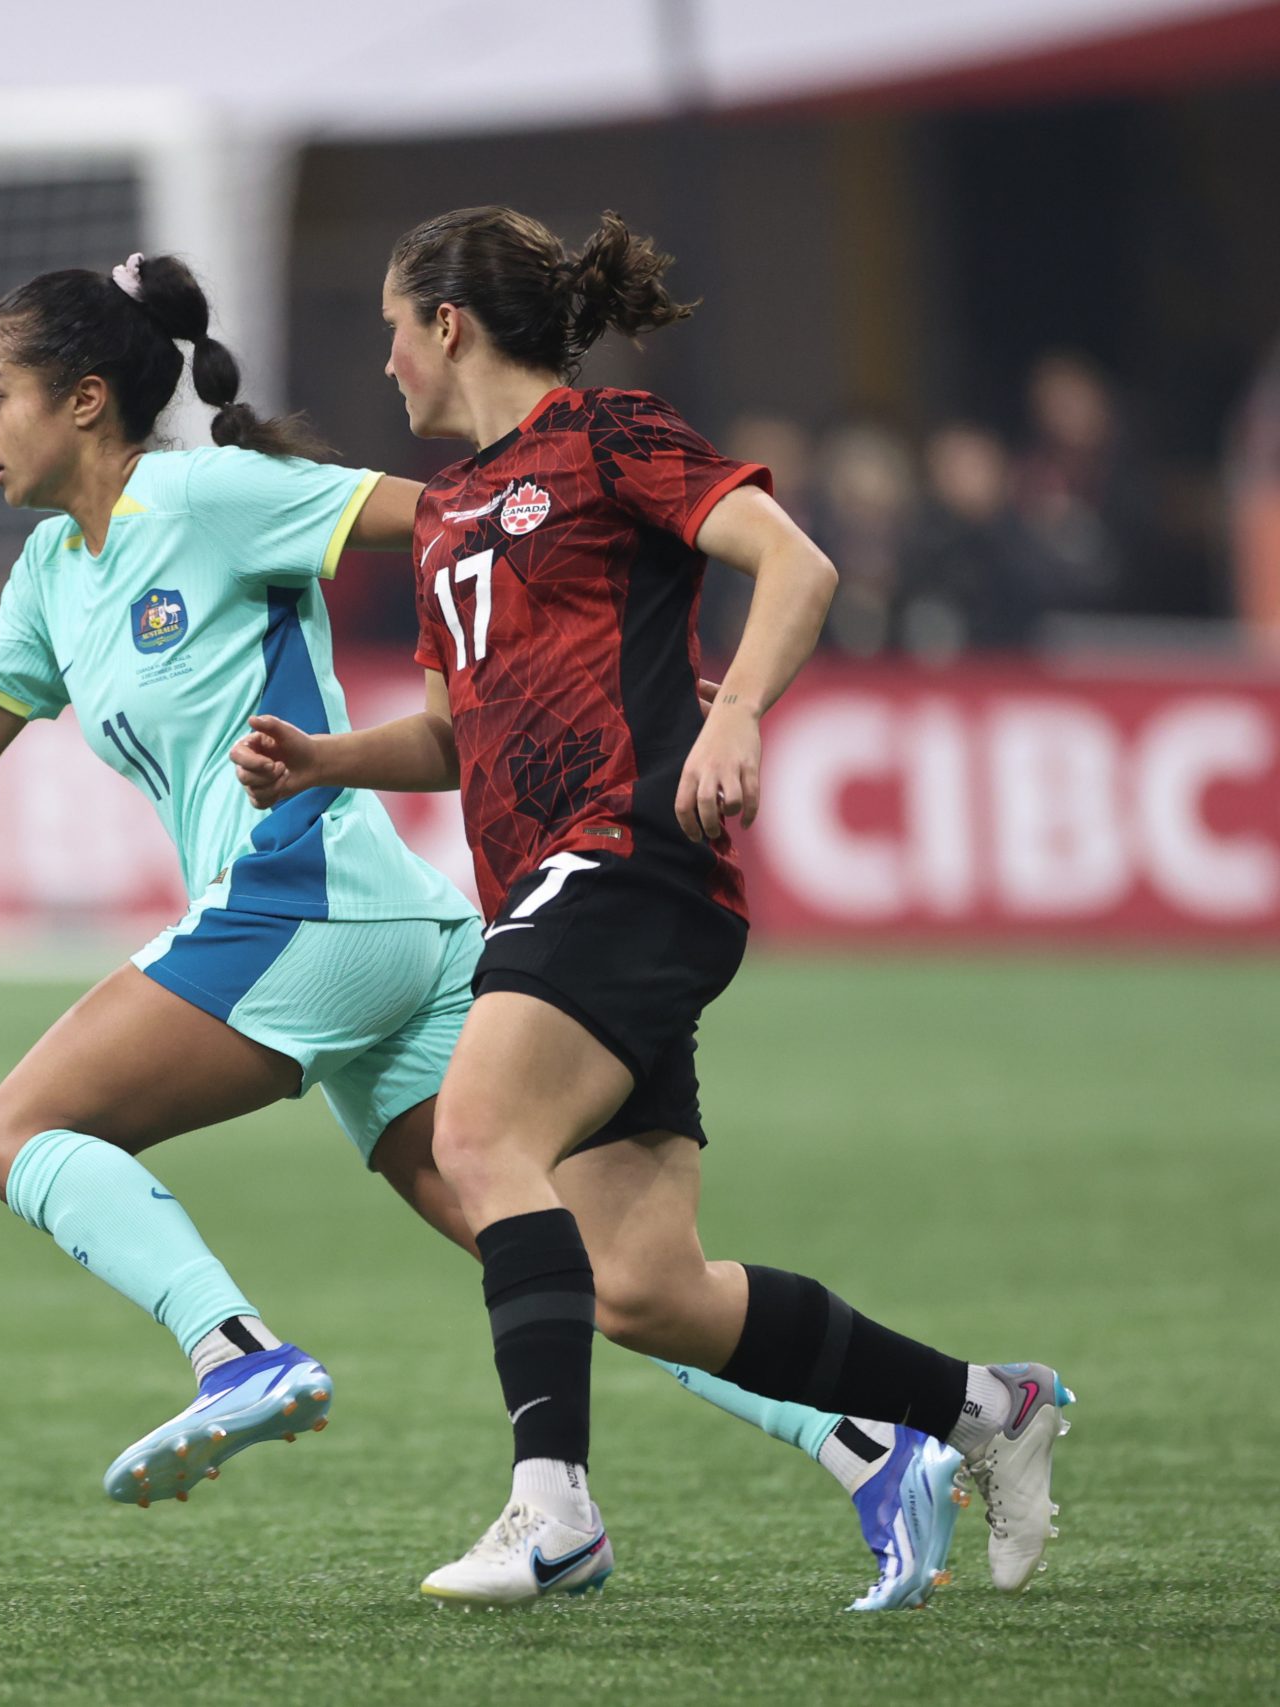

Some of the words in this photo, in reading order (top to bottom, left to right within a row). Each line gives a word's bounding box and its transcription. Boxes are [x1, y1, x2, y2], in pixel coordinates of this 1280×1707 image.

[502, 504, 548, 518] CANADA
[434, 548, 494, 671] 17
[102, 711, 170, 801] 11
[758, 694, 1278, 920] CIBC
